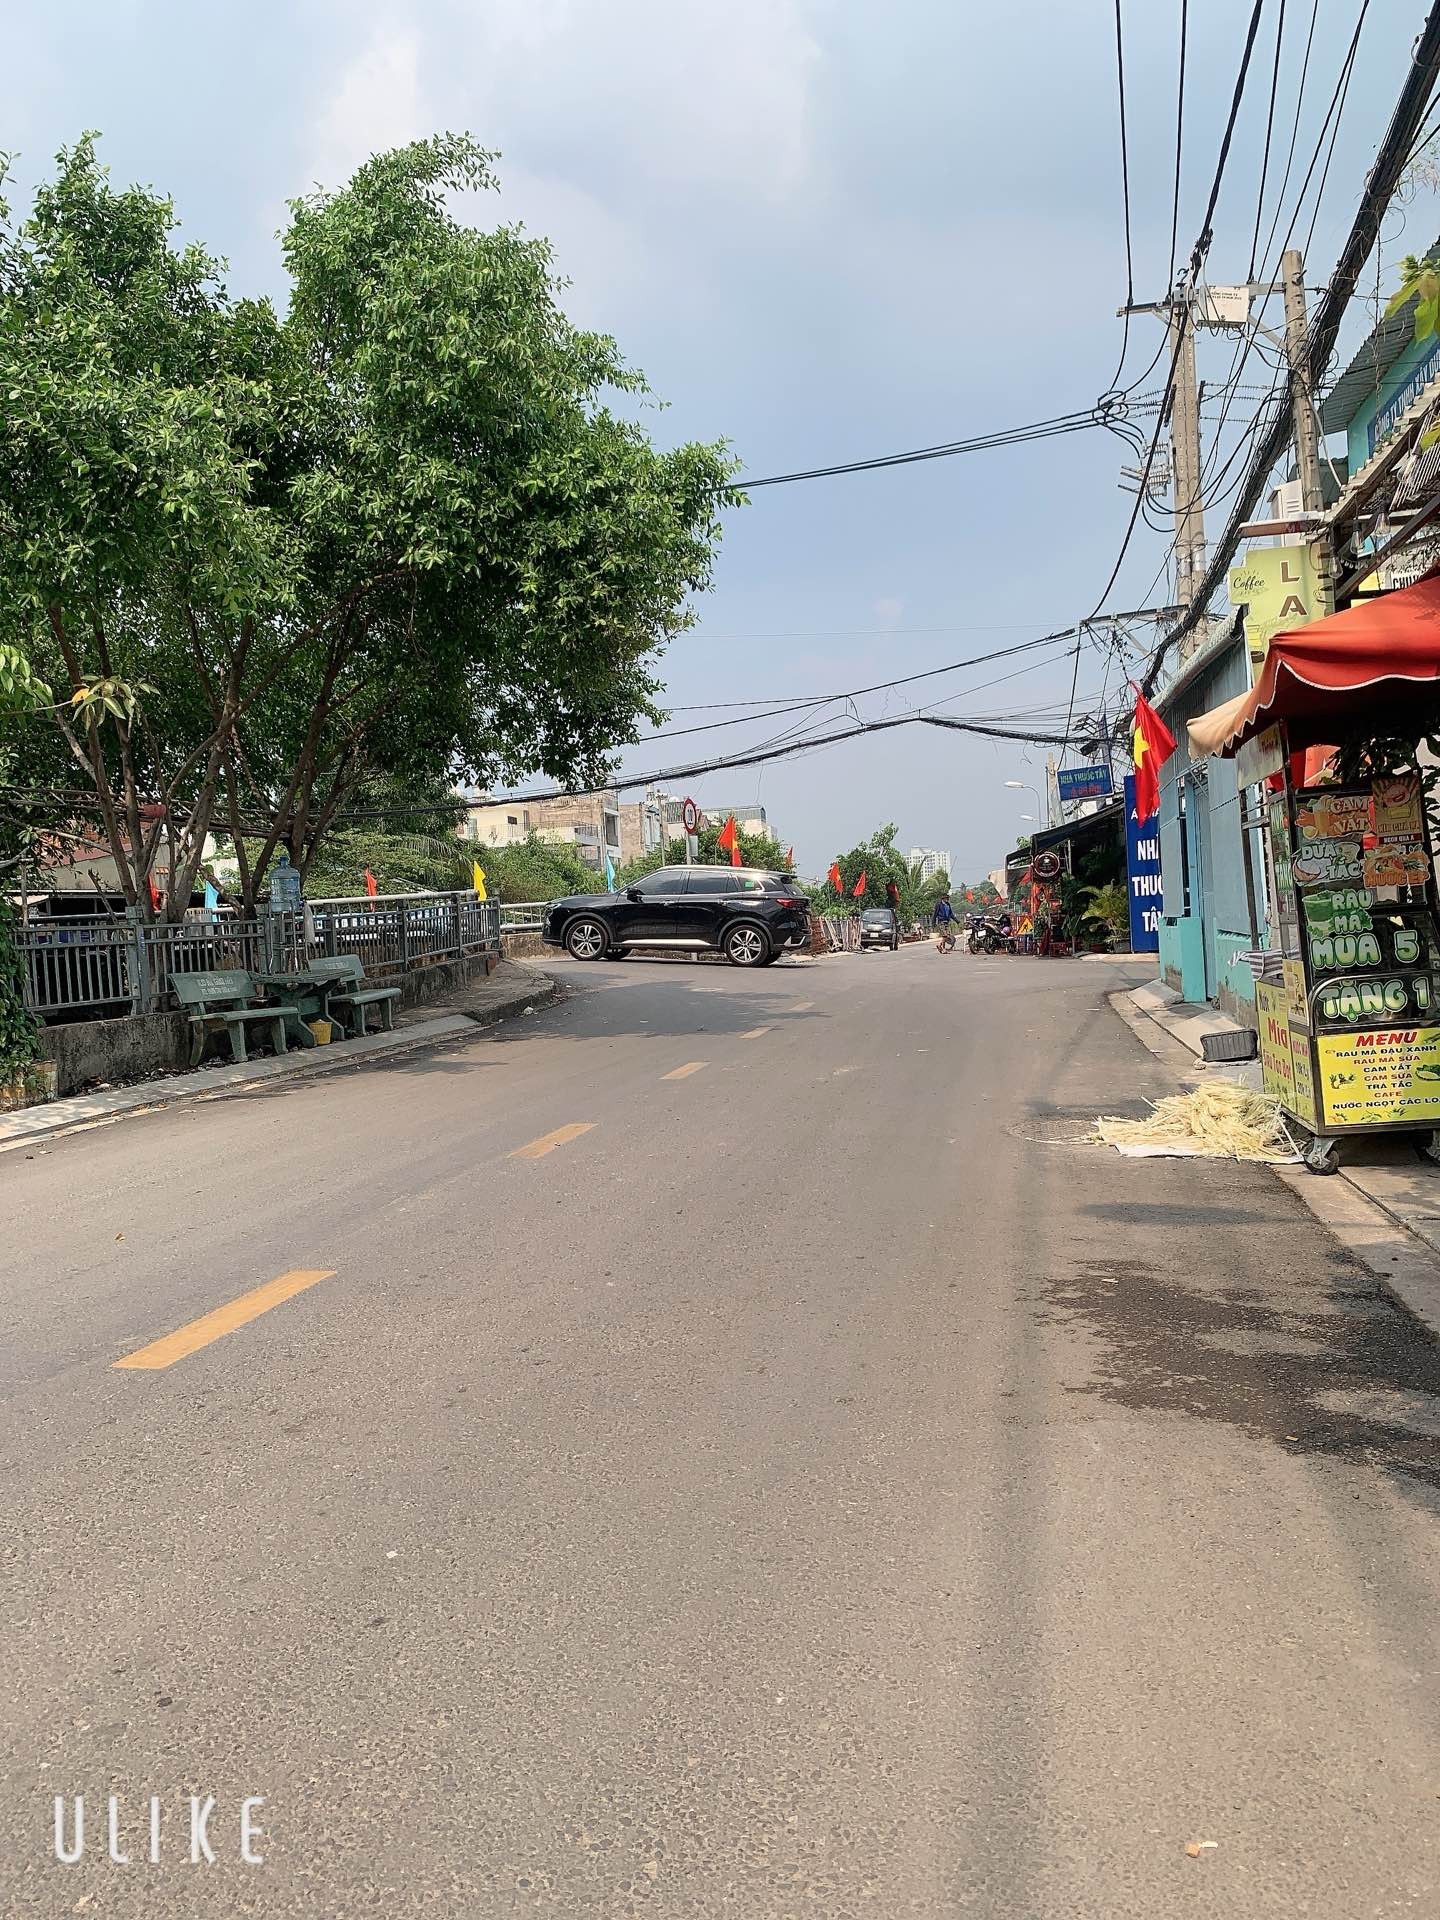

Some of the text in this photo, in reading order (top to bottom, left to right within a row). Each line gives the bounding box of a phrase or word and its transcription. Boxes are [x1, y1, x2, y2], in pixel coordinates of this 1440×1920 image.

[1233, 575, 1265, 590] Coffee
[1330, 796, 1368, 814] CAM
[1331, 889, 1373, 911] RAU
[1333, 910, 1362, 932] MÁ
[1311, 930, 1419, 969] MUA 5
[1317, 977, 1430, 1022] TẶNG 1
[1356, 1031, 1418, 1047] MENU
[1406, 1045, 1437, 1053] XANH
